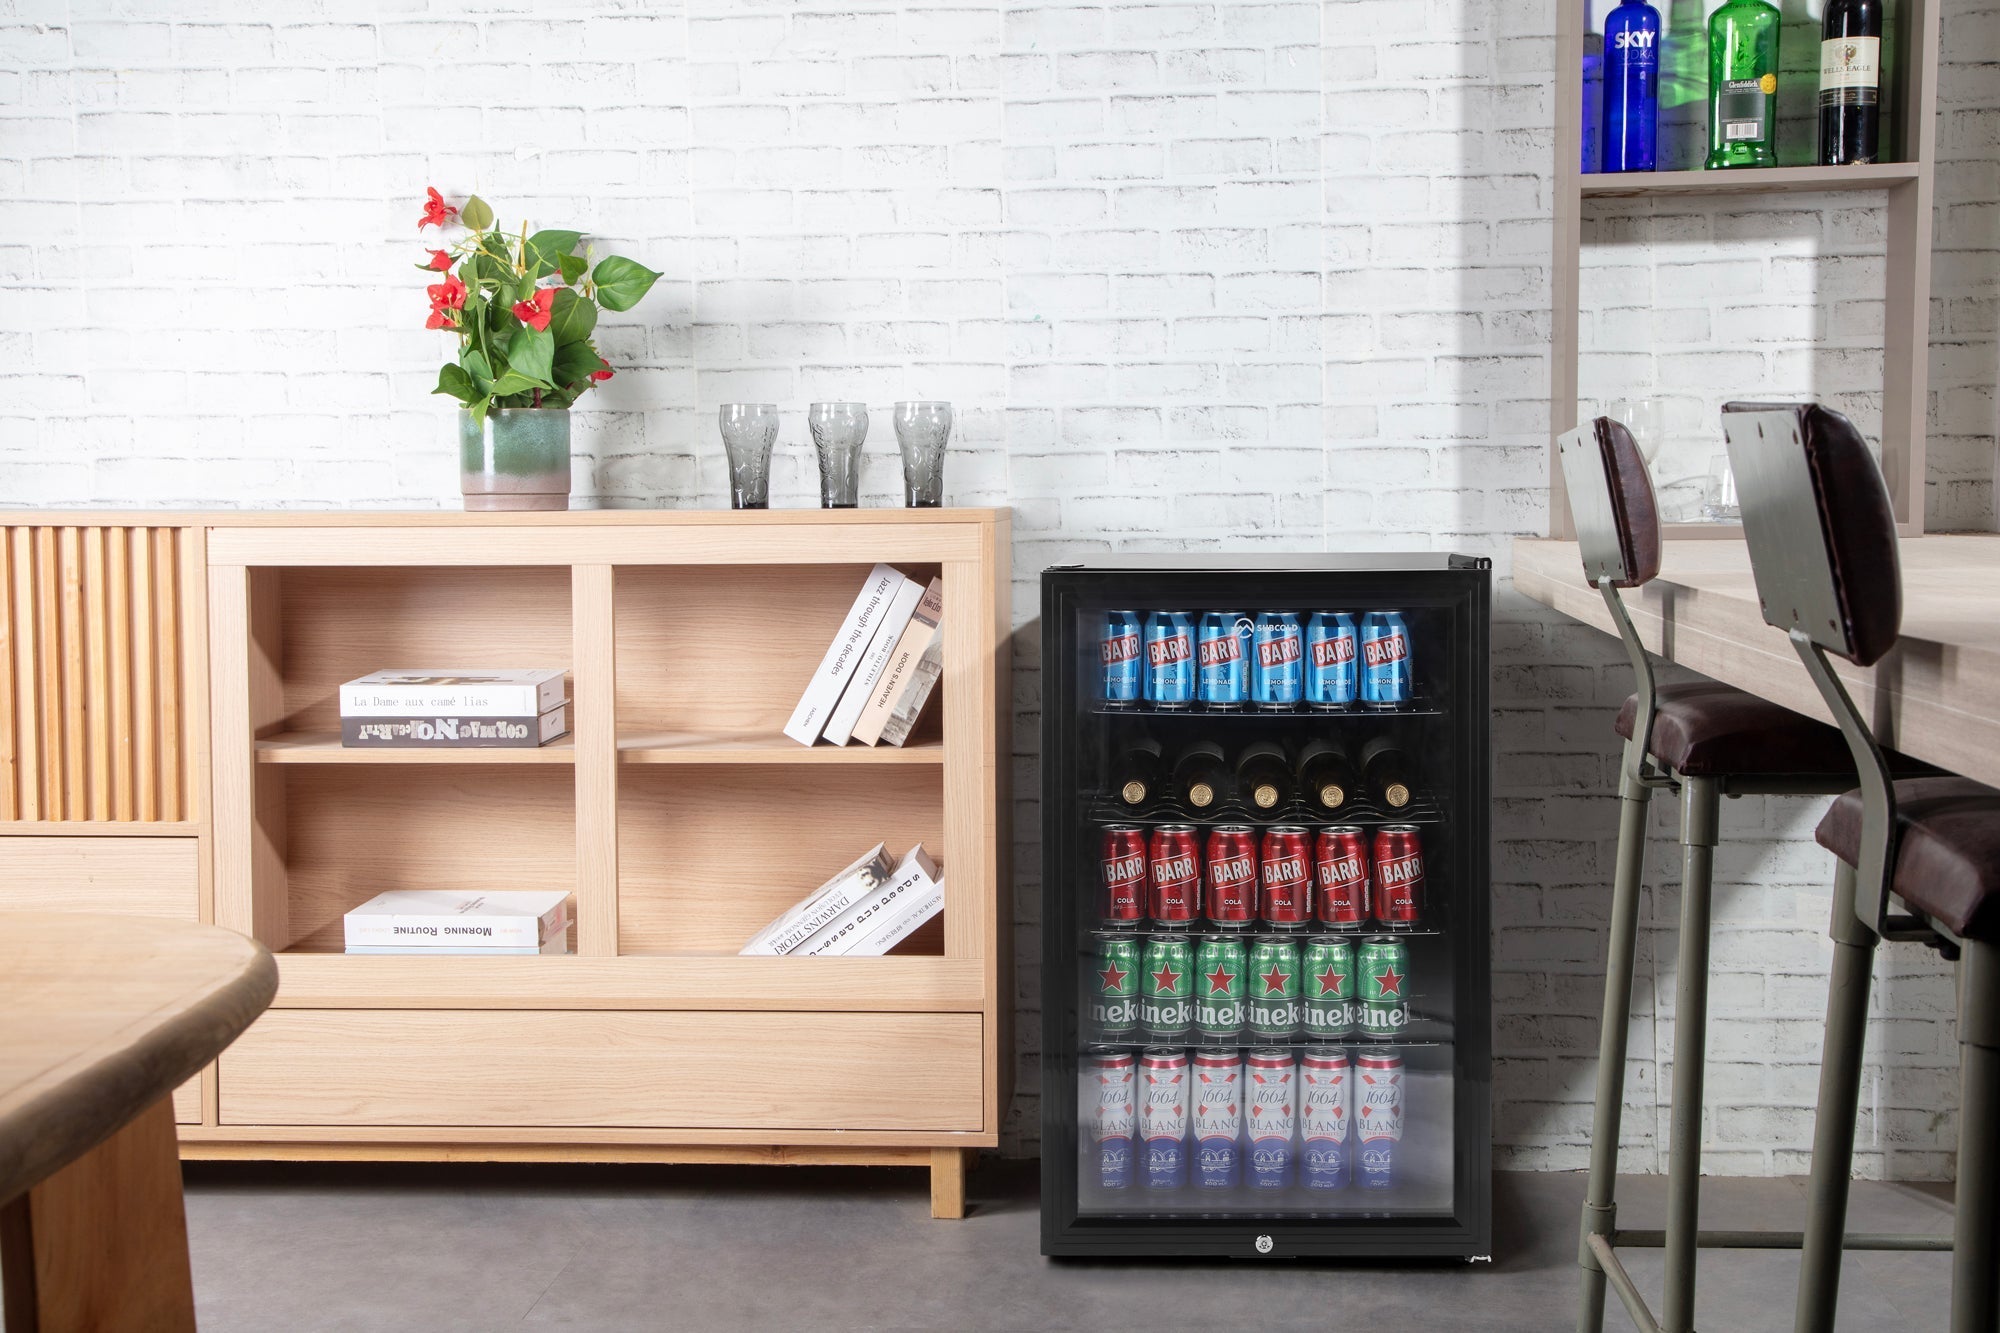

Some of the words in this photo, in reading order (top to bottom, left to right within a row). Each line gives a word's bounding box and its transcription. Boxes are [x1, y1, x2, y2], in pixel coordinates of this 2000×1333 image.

[1614, 31, 1656, 49] SKYY
[1846, 64, 1872, 72] EAGLE
[876, 577, 891, 595] Jazz
[858, 596, 881, 628] through
[850, 629, 862, 645] the
[1257, 624, 1298, 632] SUBCOLD
[1102, 637, 1139, 661] BARR
[1150, 638, 1189, 663] BARR
[1200, 638, 1239, 663] BARR
[1261, 637, 1299, 664] BARR
[1315, 638, 1354, 664] BARR
[1366, 637, 1405, 664] BARR
[831, 643, 854, 677] decades
[877, 672, 899, 709] HEAVEN'S
[895, 651, 910, 674] DOOR
[354, 697, 367, 706] La
[373, 697, 399, 706] Dame
[464, 696, 489, 706] lias
[460, 720, 528, 740] CORMAC
[1106, 857, 1143, 882] BARR
[1155, 857, 1194, 883] BARR
[1213, 858, 1252, 884] BARR
[1264, 858, 1303, 884] BARR
[1321, 858, 1360, 885] BARR
[1382, 857, 1422, 884] BARR
[880, 873, 920, 906] speed
[803, 895, 851, 933] DARWINS
[856, 903, 880, 924] and
[393, 926, 438, 936] ROUTINE
[444, 926, 492, 937] MORNING
[774, 930, 806, 956] TEORI
[1100, 1089, 1129, 1104] 1664
[1149, 1089, 1178, 1104] 1664
[1202, 1089, 1232, 1104] 1664
[1256, 1089, 1288, 1104] 1664
[1307, 1090, 1339, 1105] 1664
[1366, 1090, 1398, 1105] 1664
[1092, 1117, 1135, 1131] BLANC
[1141, 1117, 1185, 1131] BLANC
[1195, 1117, 1239, 1130] BLANC
[1250, 1117, 1294, 1131] BLANC
[1302, 1118, 1346, 1131] BLANC
[1359, 1118, 1402, 1131] BLANC
